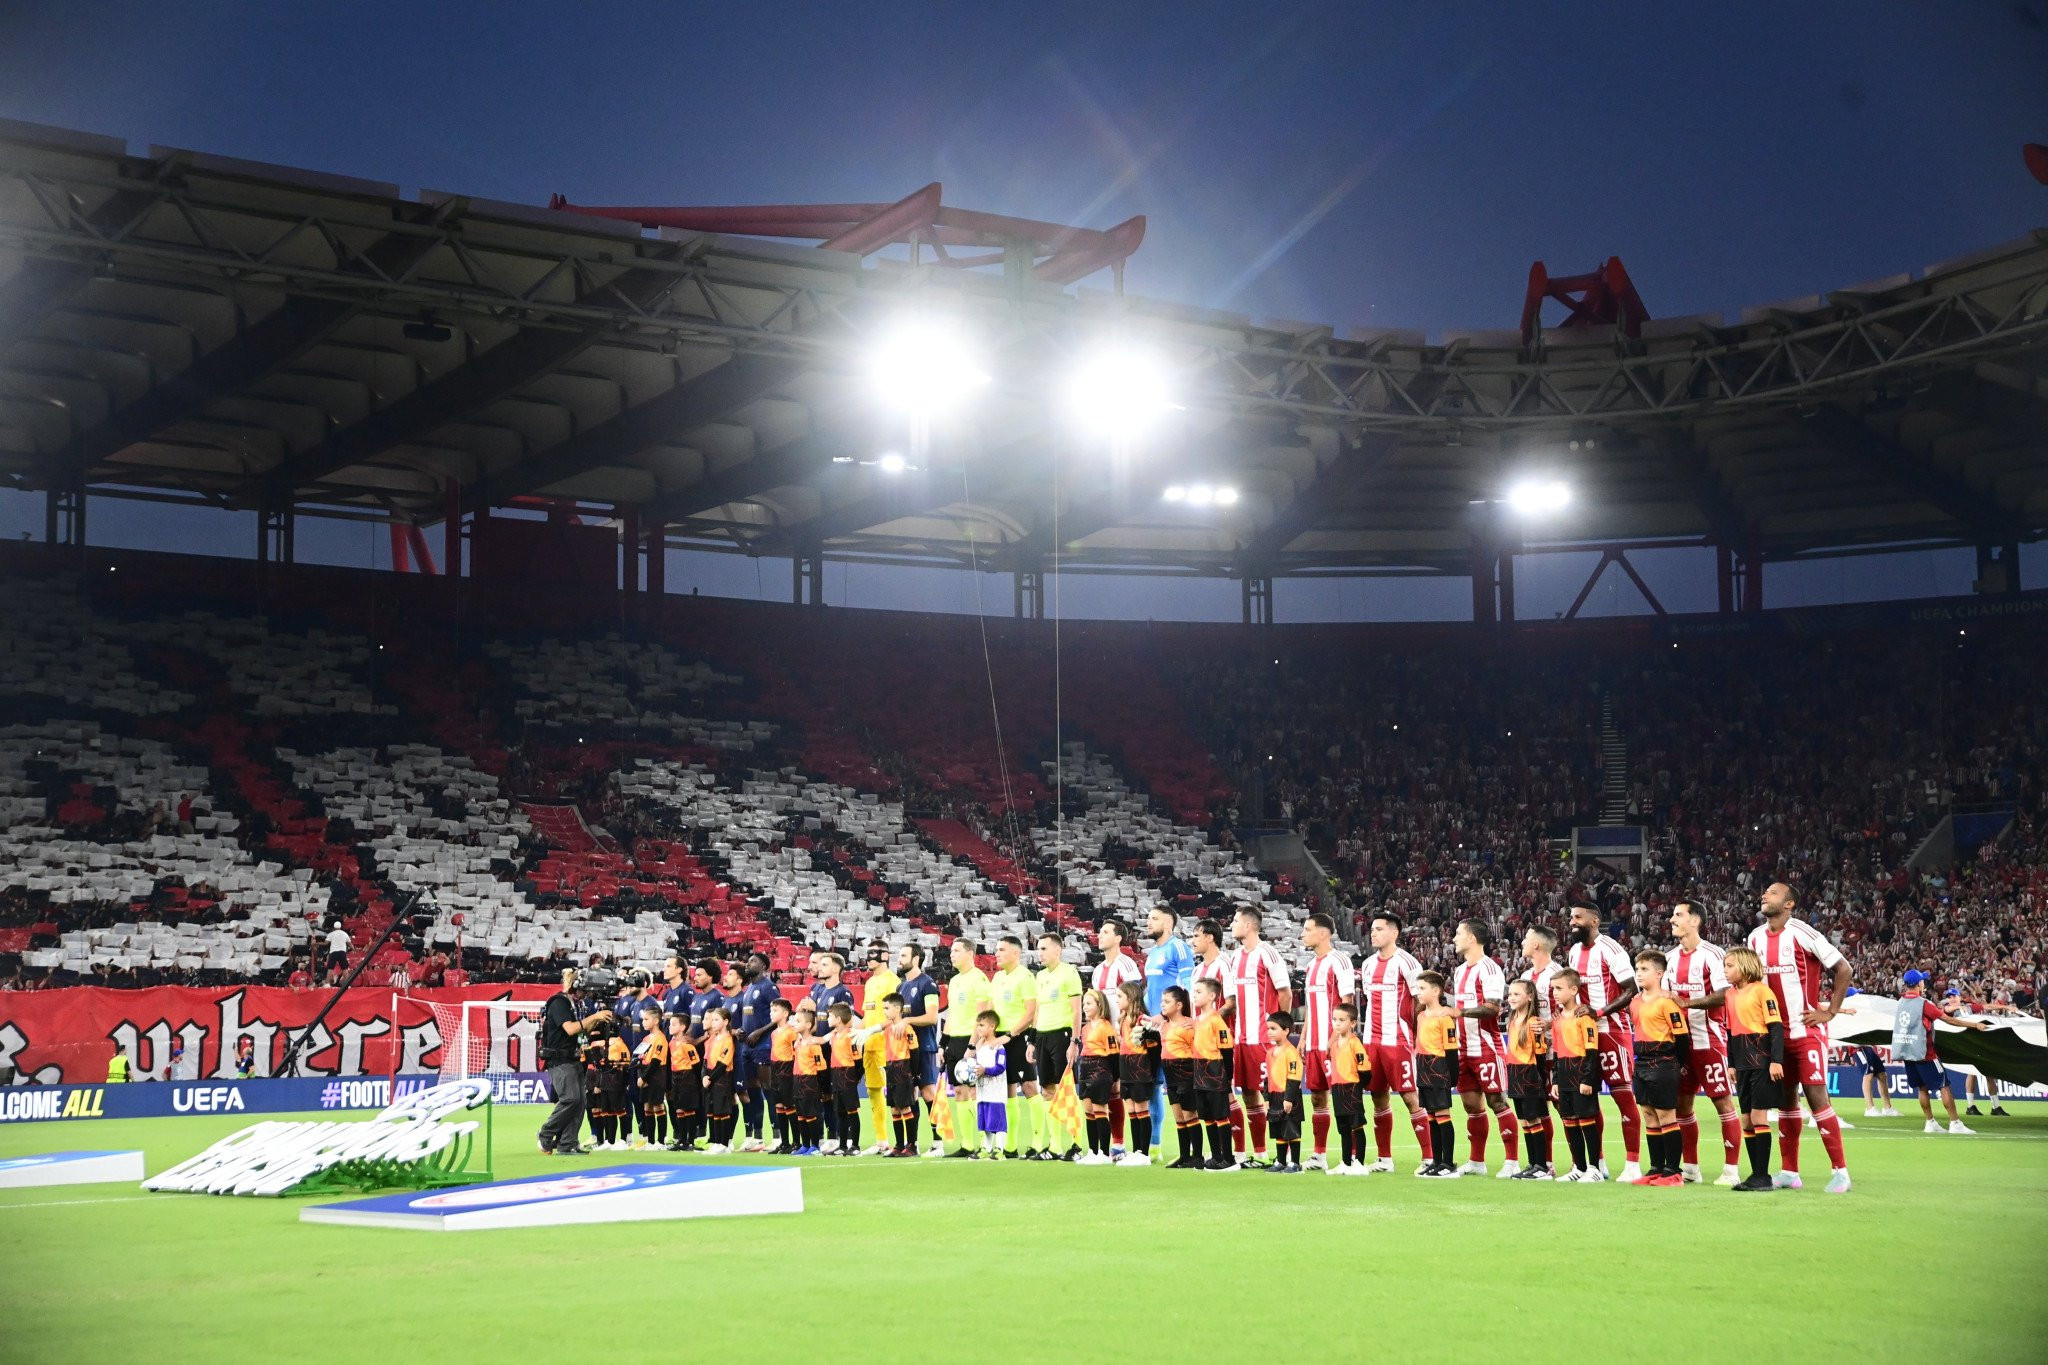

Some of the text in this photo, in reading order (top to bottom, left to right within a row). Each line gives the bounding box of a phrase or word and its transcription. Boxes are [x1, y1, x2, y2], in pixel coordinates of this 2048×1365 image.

[1401, 1060, 1411, 1079] 3
[1600, 1051, 1618, 1071] 23
[1807, 1049, 1820, 1070] 9
[1479, 1062, 1496, 1081] 27
[1705, 1062, 1725, 1083] 22
[0, 1088, 105, 1120] LCOME ALL
[173, 1087, 245, 1112] UEFA
